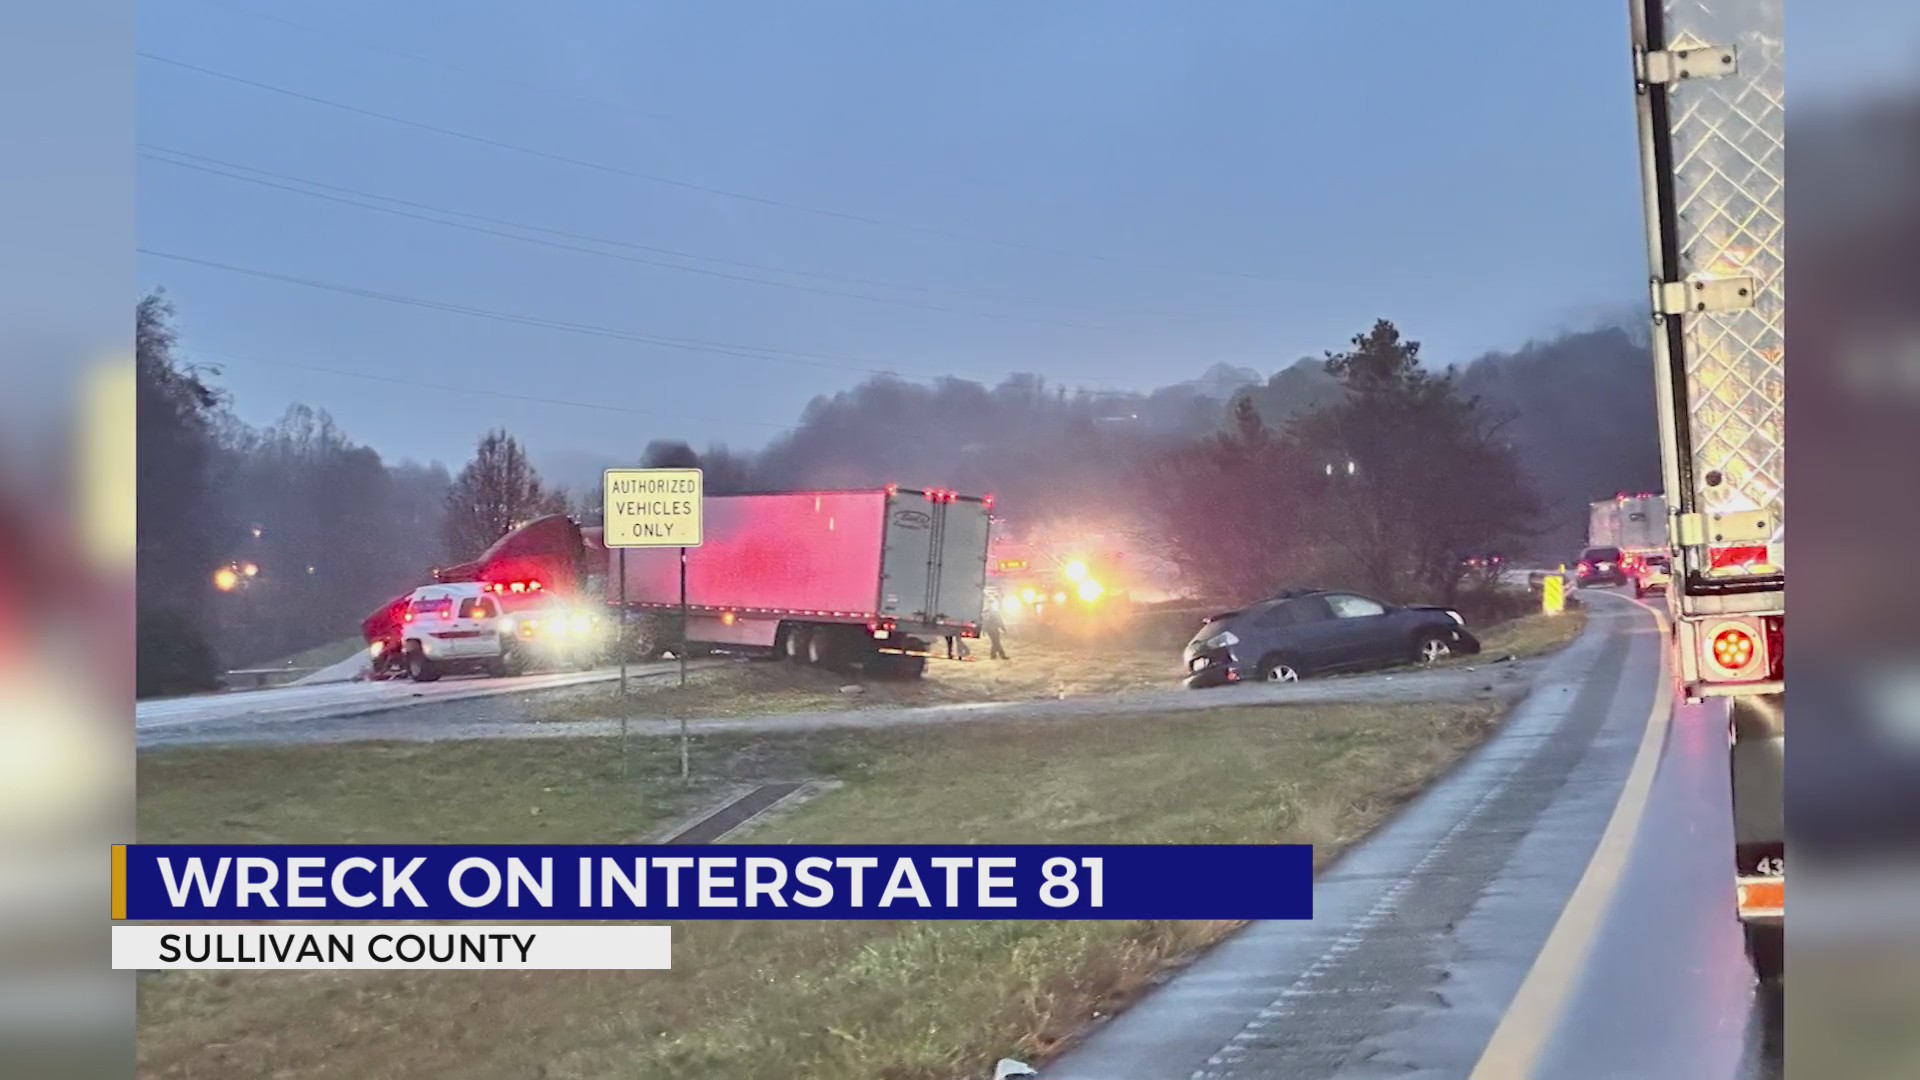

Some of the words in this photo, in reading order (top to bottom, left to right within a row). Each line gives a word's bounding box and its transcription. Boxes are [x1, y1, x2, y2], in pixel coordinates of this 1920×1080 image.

[612, 479, 696, 494] AUTHORIZED
[616, 501, 692, 516] VEHICLES
[632, 523, 674, 537] ONLY
